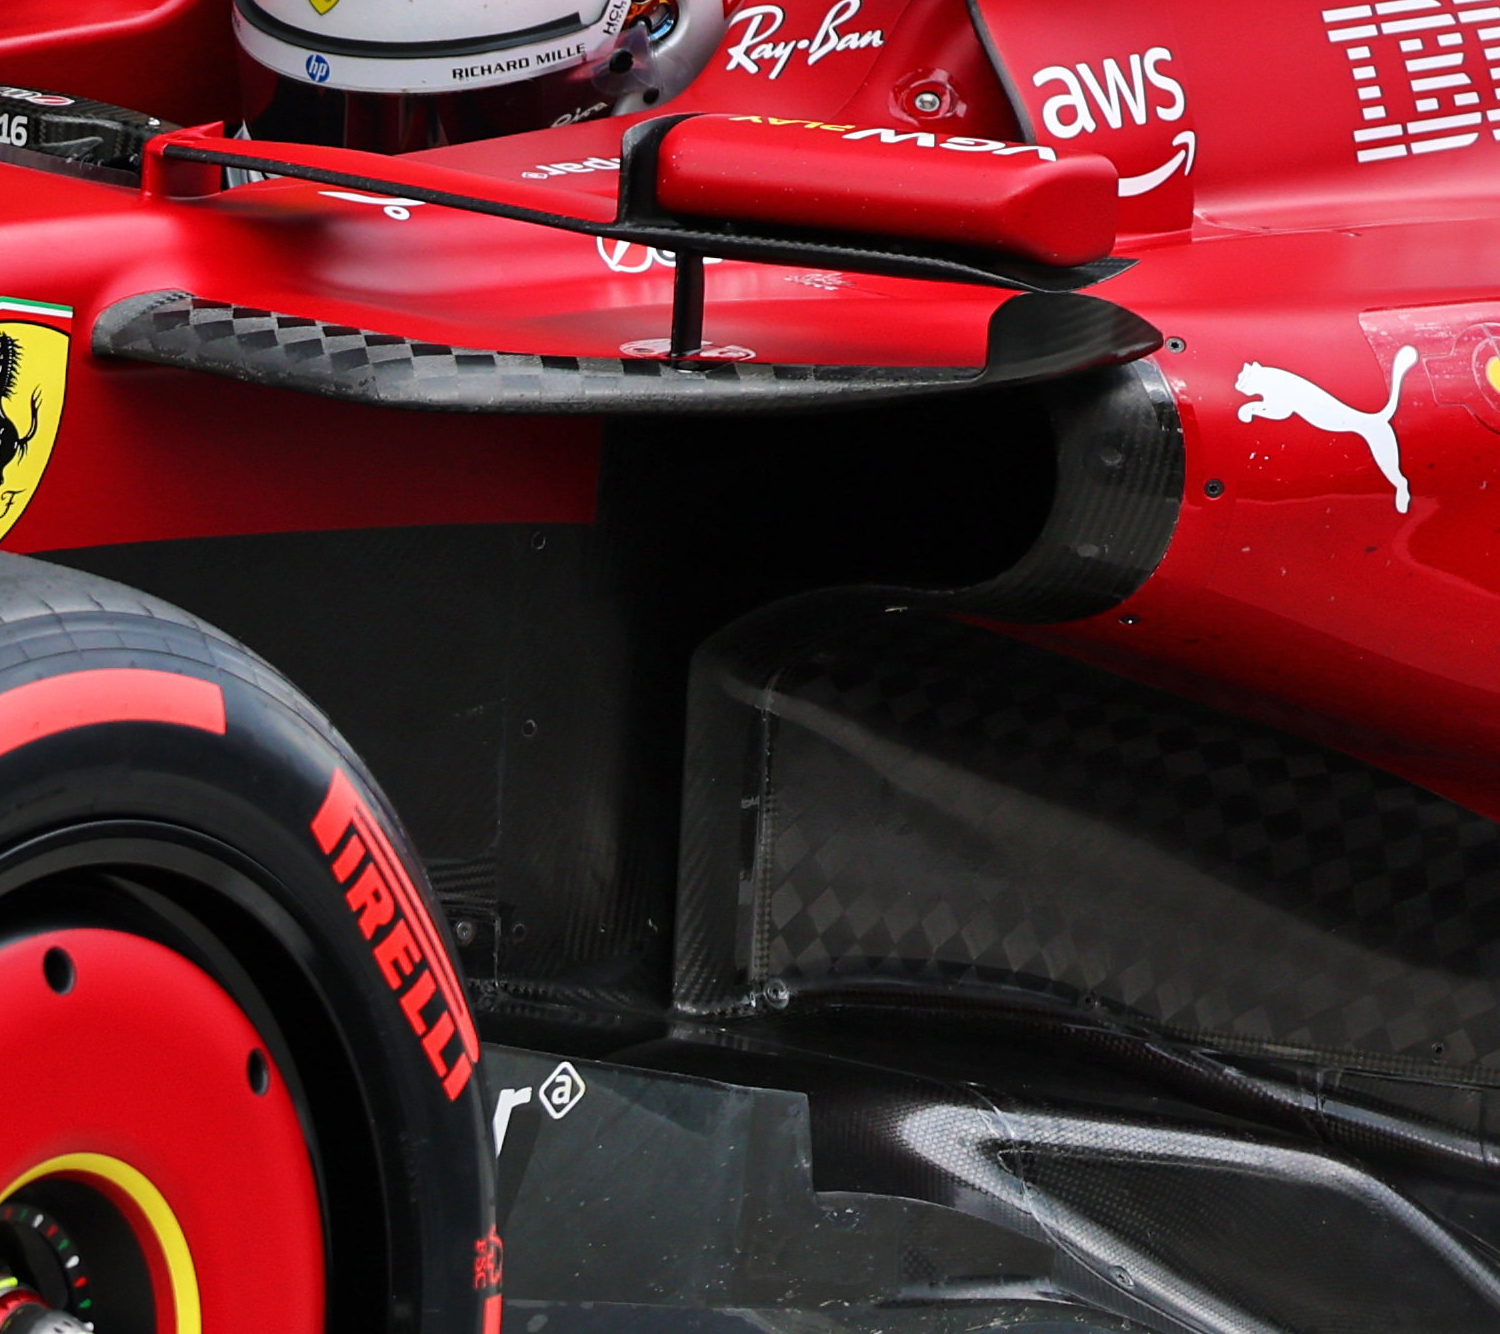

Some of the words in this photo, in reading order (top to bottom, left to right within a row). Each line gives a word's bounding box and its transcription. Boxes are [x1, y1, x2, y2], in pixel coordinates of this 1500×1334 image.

[451, 56, 530, 80] RICHARD
[536, 43, 587, 65] MILLE
[1032, 46, 1186, 139] aws
[728, 115, 855, 132] PLAY
[842, 127, 1057, 162] VGW
[311, 765, 480, 1102] PIRELLI
